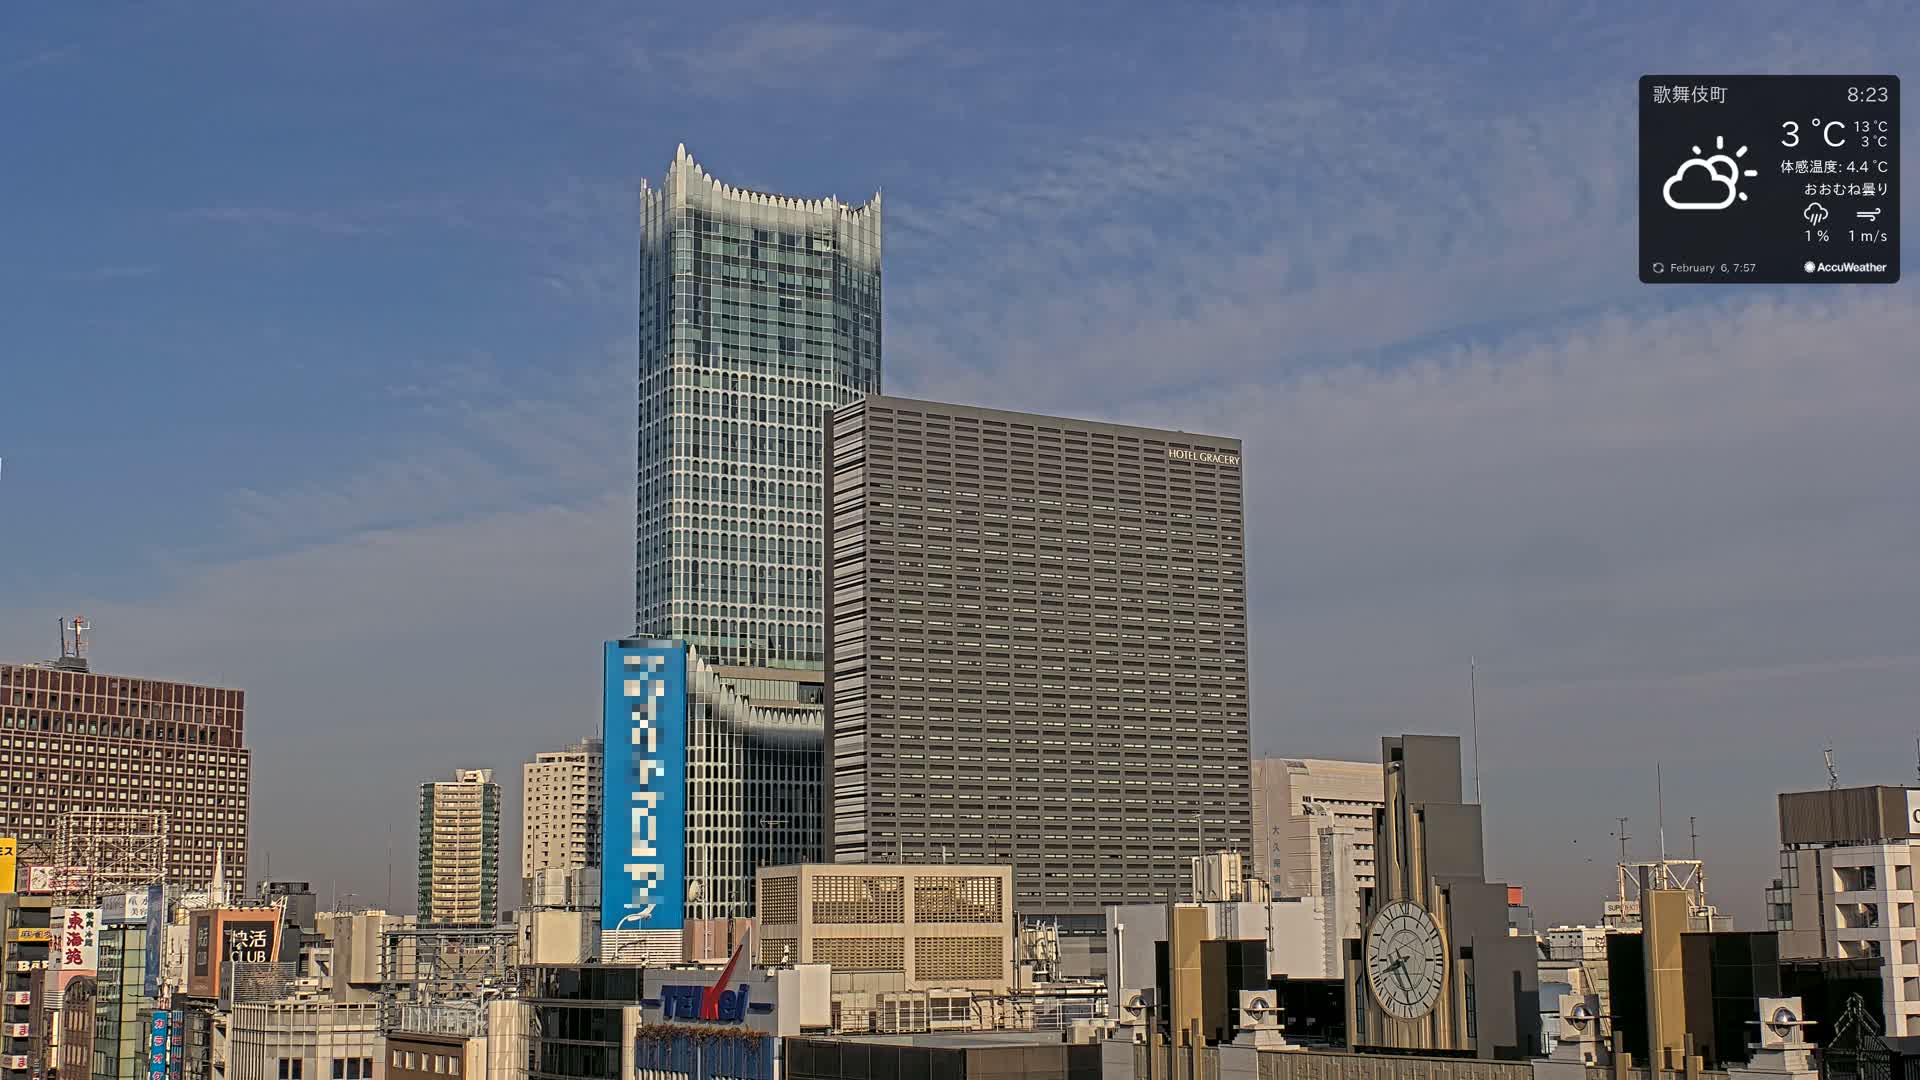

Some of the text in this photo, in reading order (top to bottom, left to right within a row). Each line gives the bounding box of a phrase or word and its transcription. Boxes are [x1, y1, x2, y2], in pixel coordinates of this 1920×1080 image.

[1168, 448, 1241, 465] HOTEL GRACERY
[64, 911, 84, 965] 東海苑
[231, 929, 267, 949] 快活
[231, 950, 266, 963] CLUB
